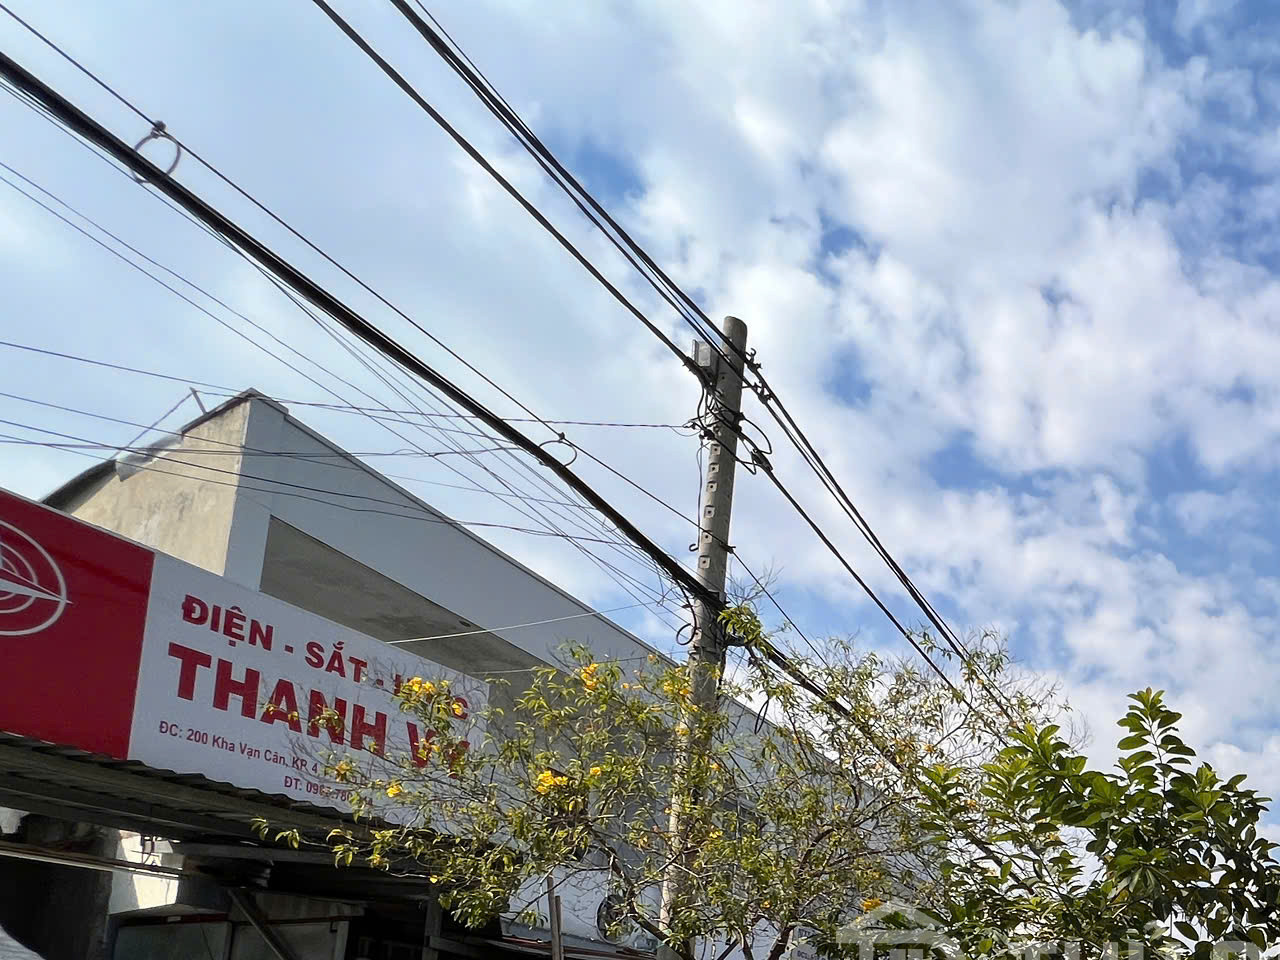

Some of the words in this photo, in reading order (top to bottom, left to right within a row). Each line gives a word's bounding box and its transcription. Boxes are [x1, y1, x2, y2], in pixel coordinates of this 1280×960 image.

[182, 594, 274, 651] ĐIỆN
[305, 641, 367, 683] SẮT
[159, 720, 182, 738] ĐC:
[186, 728, 208, 745] 200
[212, 735, 235, 753] Kha
[239, 742, 260, 760] Vạn
[168, 642, 387, 757] THANH
